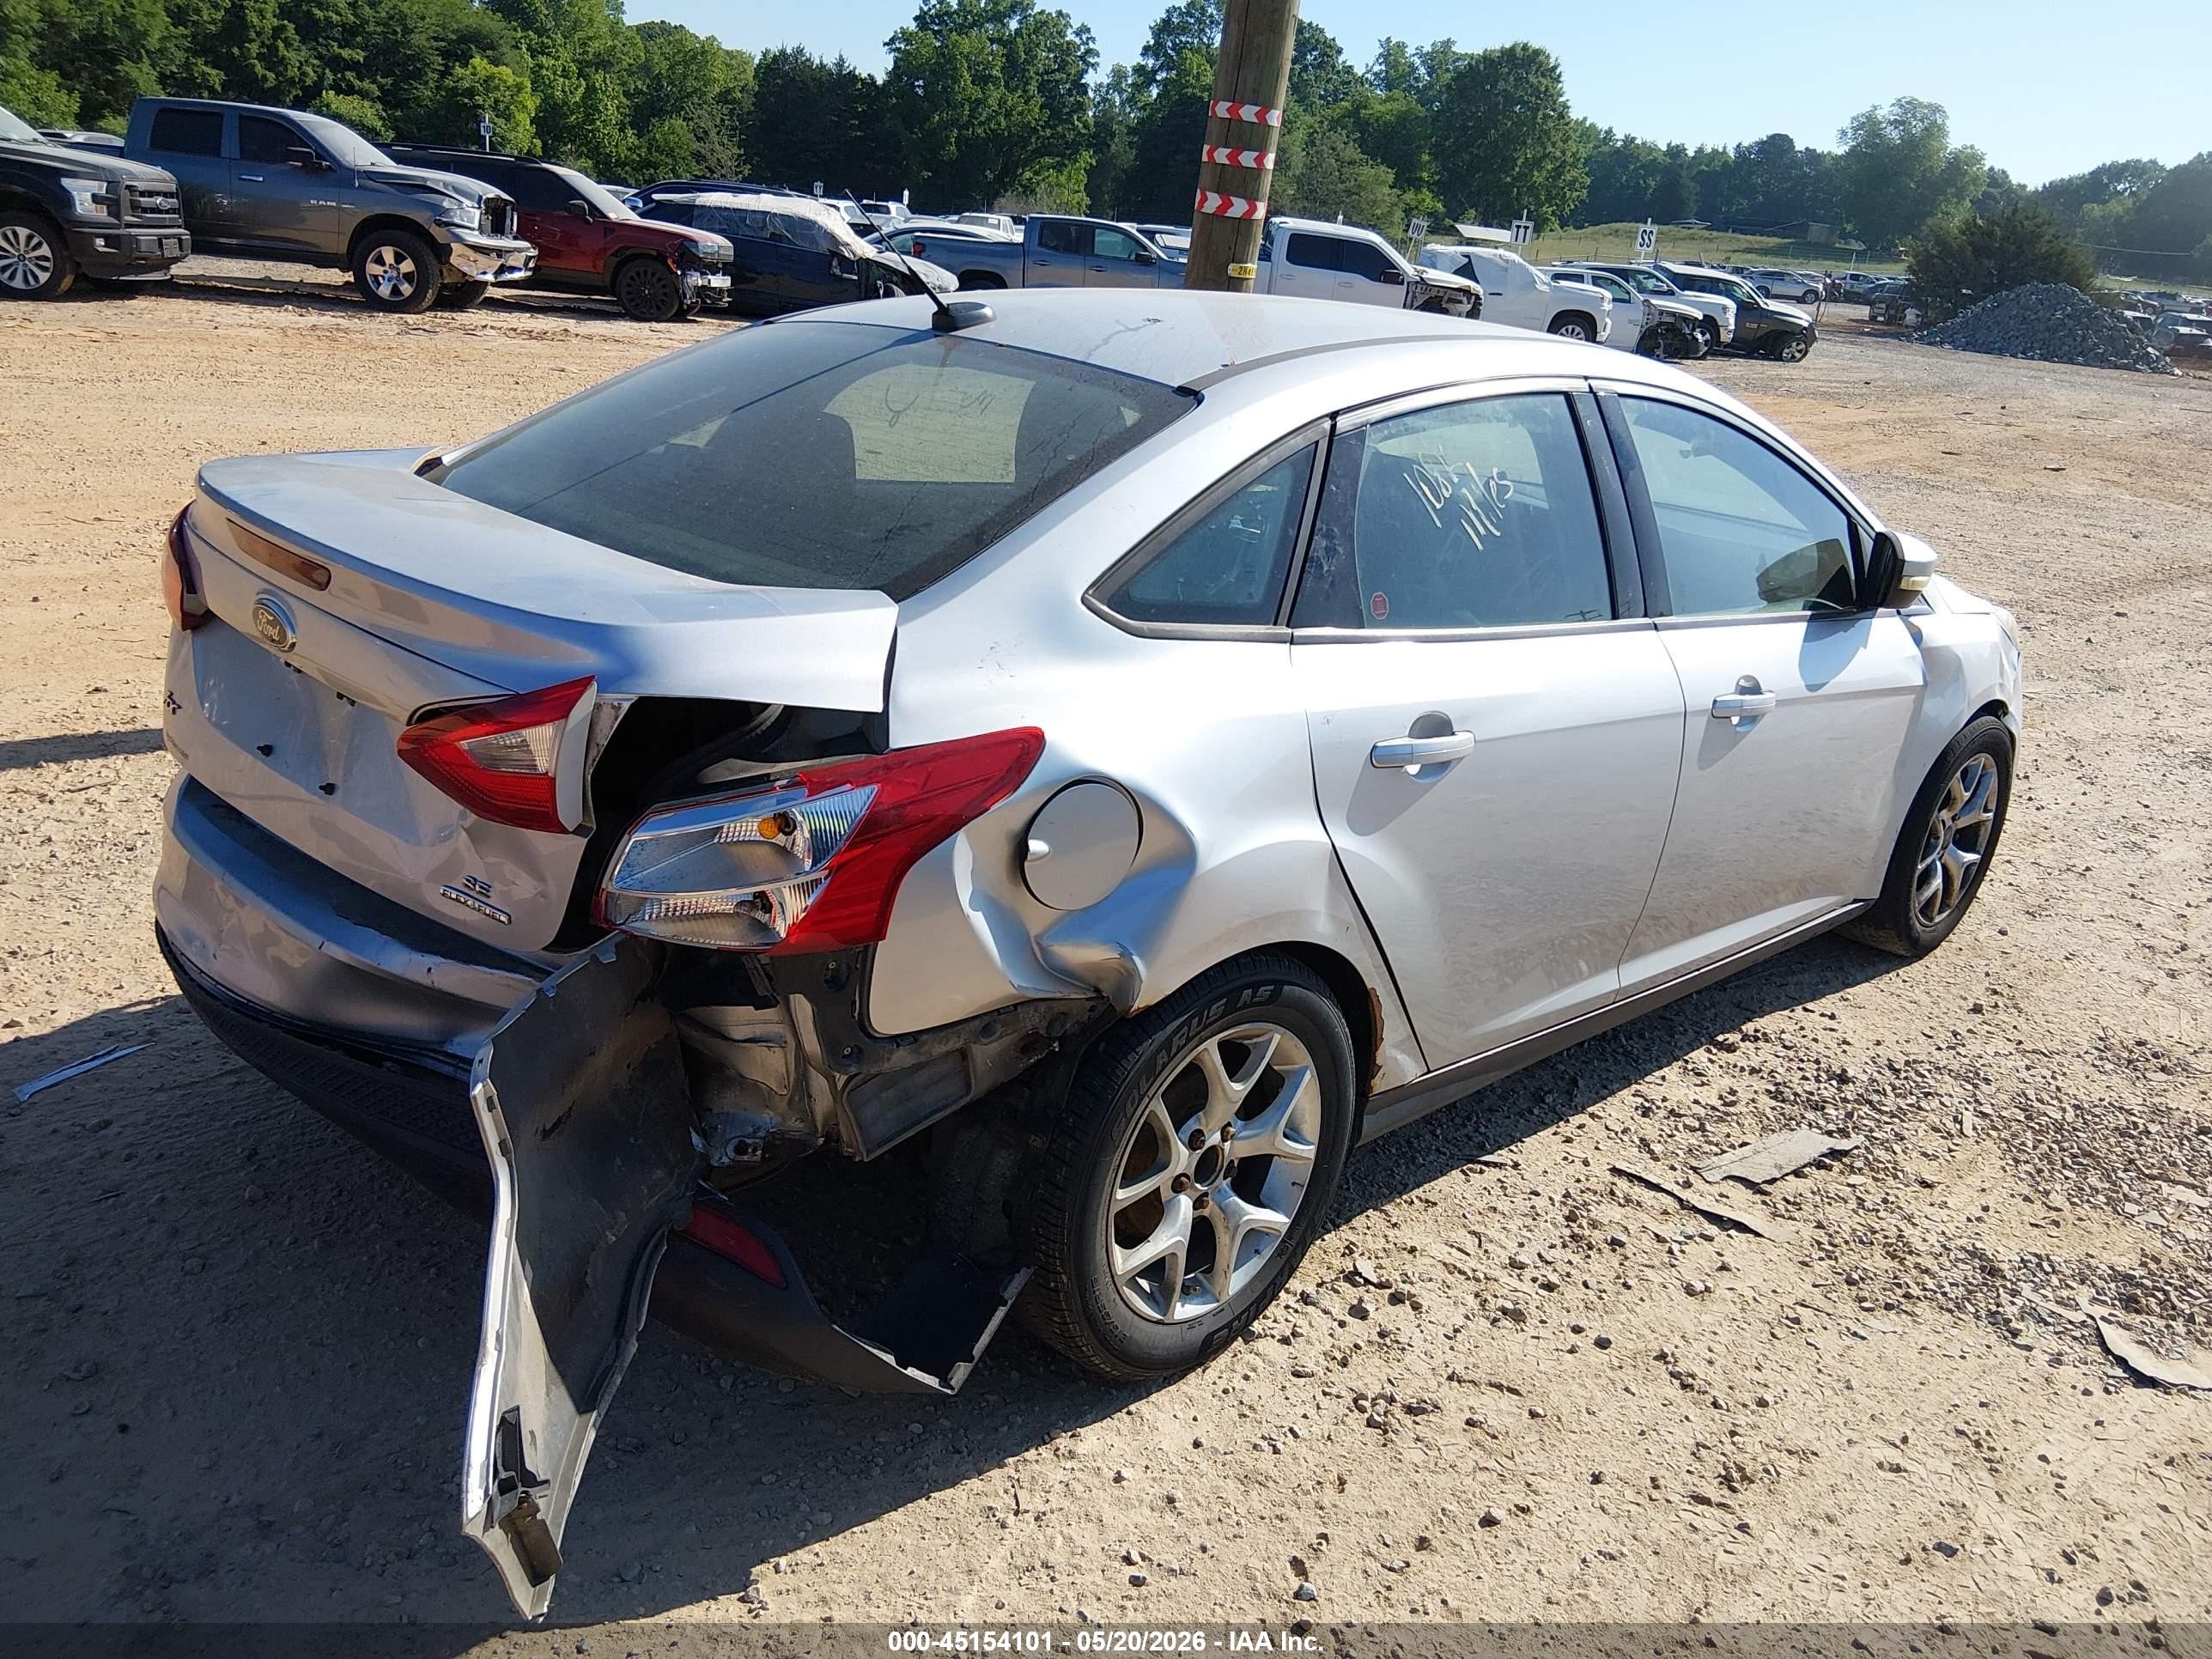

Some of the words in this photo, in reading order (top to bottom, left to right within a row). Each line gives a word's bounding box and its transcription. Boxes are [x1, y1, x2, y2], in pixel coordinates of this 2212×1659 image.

[483, 125, 491, 134] 10
[309, 198, 337, 207] RAM
[1411, 222, 1425, 237] UU
[1515, 224, 1530, 244] TT
[1639, 228, 1654, 249] SS
[257, 609, 282, 641] Ford
[460, 874, 492, 899] SE
[440, 886, 468, 905] FLEX
[476, 902, 509, 926] FUEL
[1108, 997, 1227, 1143] SOLARUS
[1237, 984, 1274, 1009] AS
